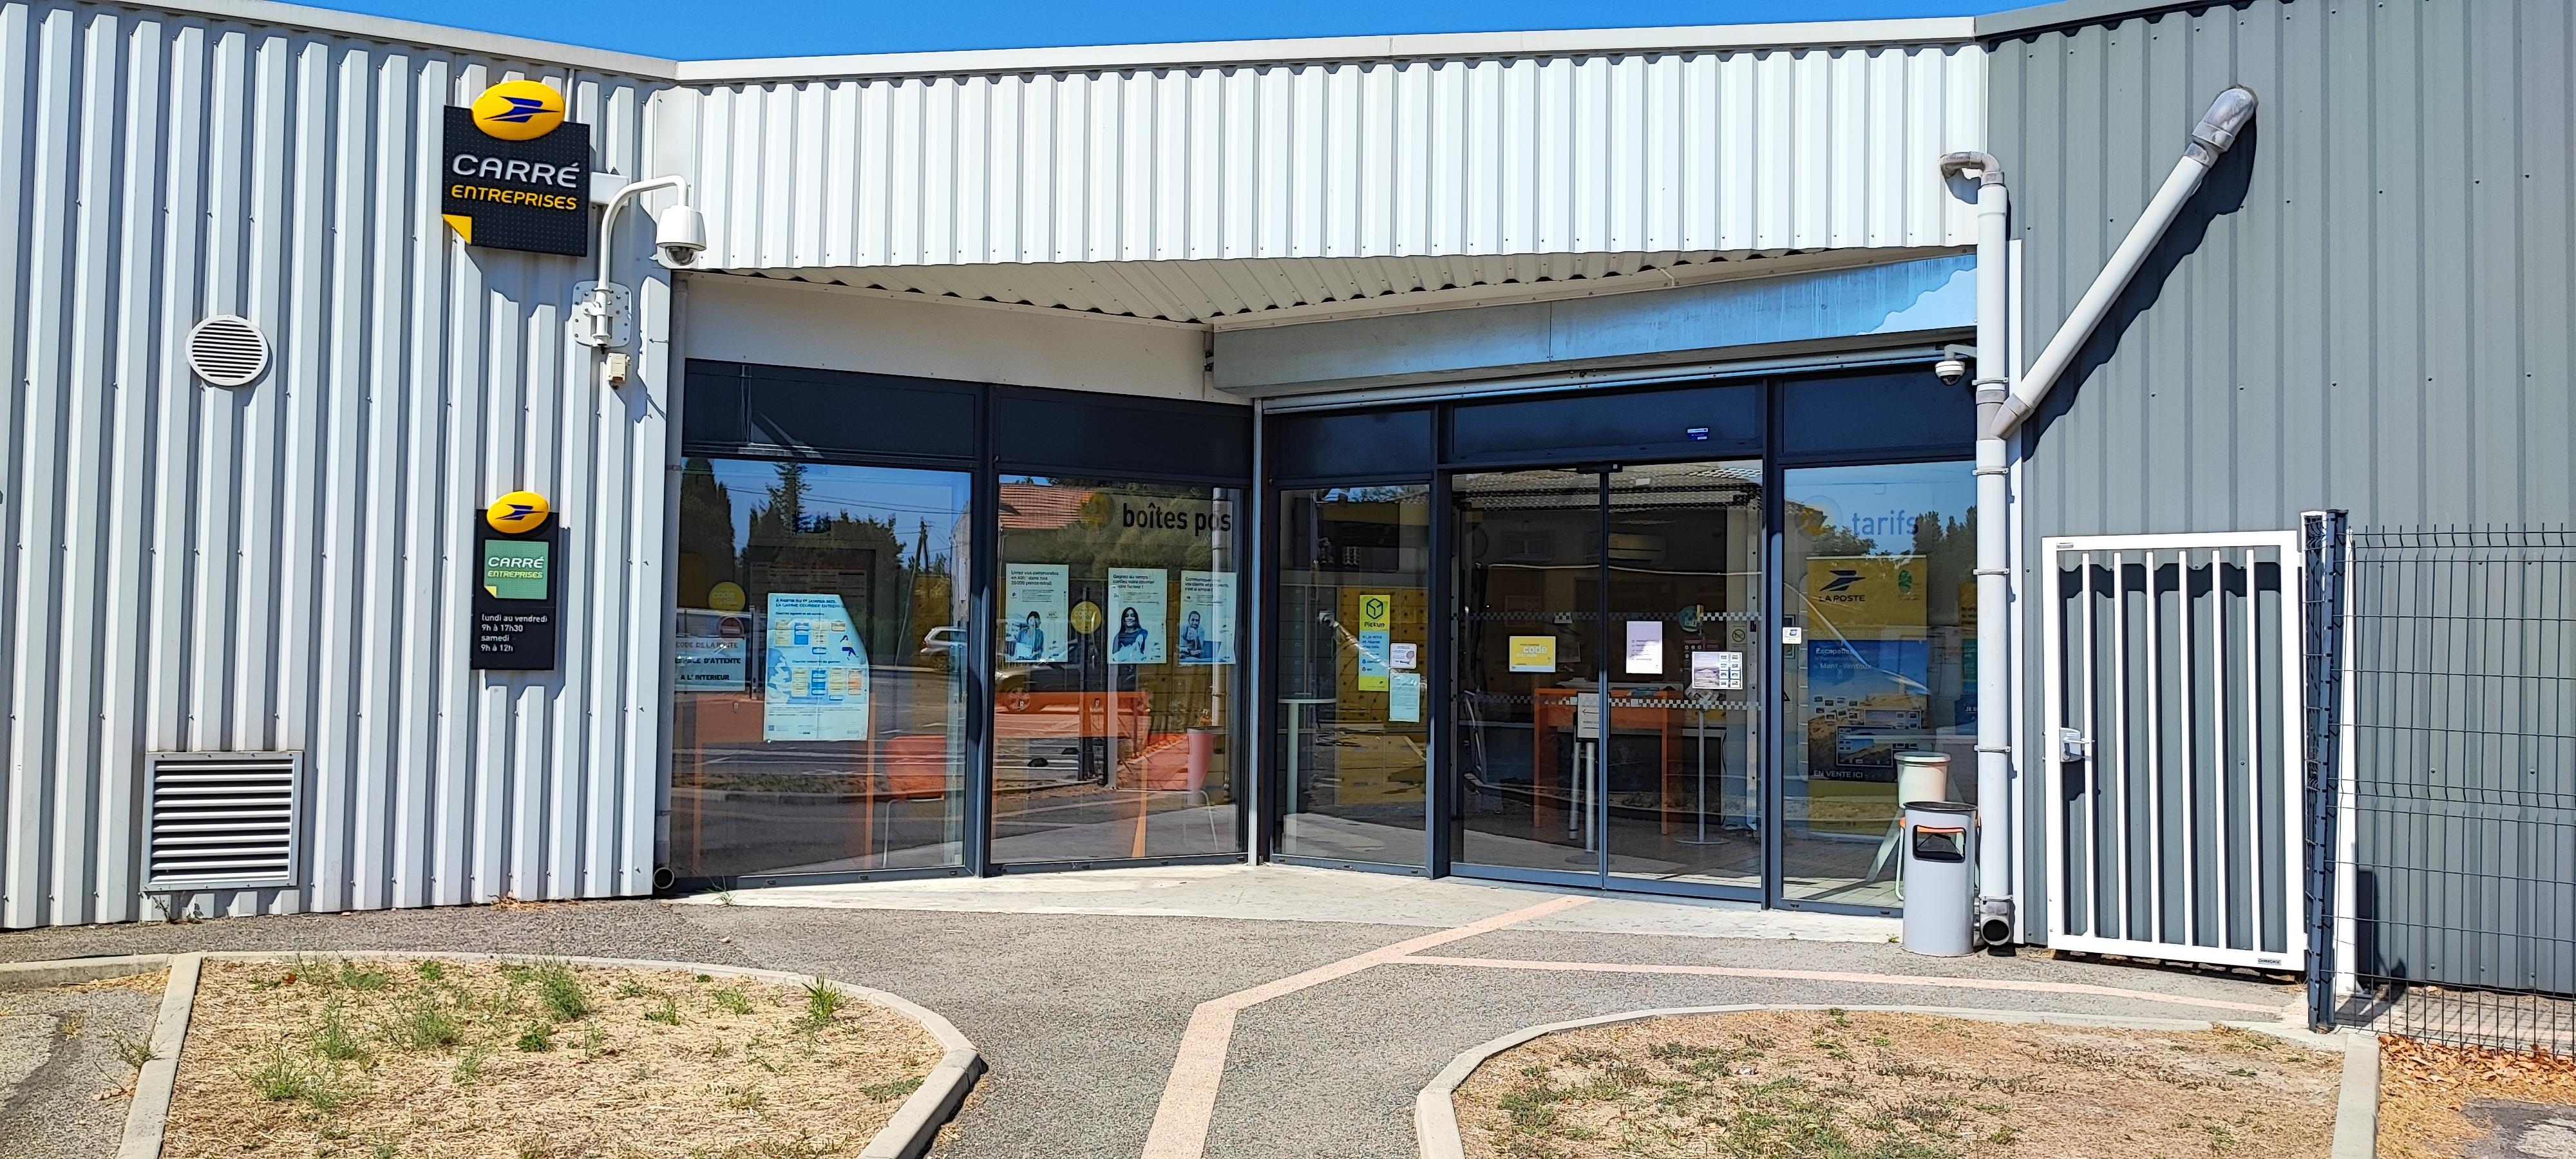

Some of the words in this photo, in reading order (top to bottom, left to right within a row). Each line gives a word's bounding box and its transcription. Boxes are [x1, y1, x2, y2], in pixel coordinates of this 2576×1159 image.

[452, 154, 580, 188] CARRÉ
[451, 184, 577, 210] ENTREPRISES
[1122, 502, 1188, 529] boîtes
[1852, 509, 1918, 536] tarifs
[488, 556, 545, 569] CARRÉ
[488, 570, 543, 578] ENTREPRISES
[712, 590, 735, 599] code
[515, 614, 547, 623] vendredi
[493, 623, 498, 632] à
[1524, 645, 1548, 653] code
